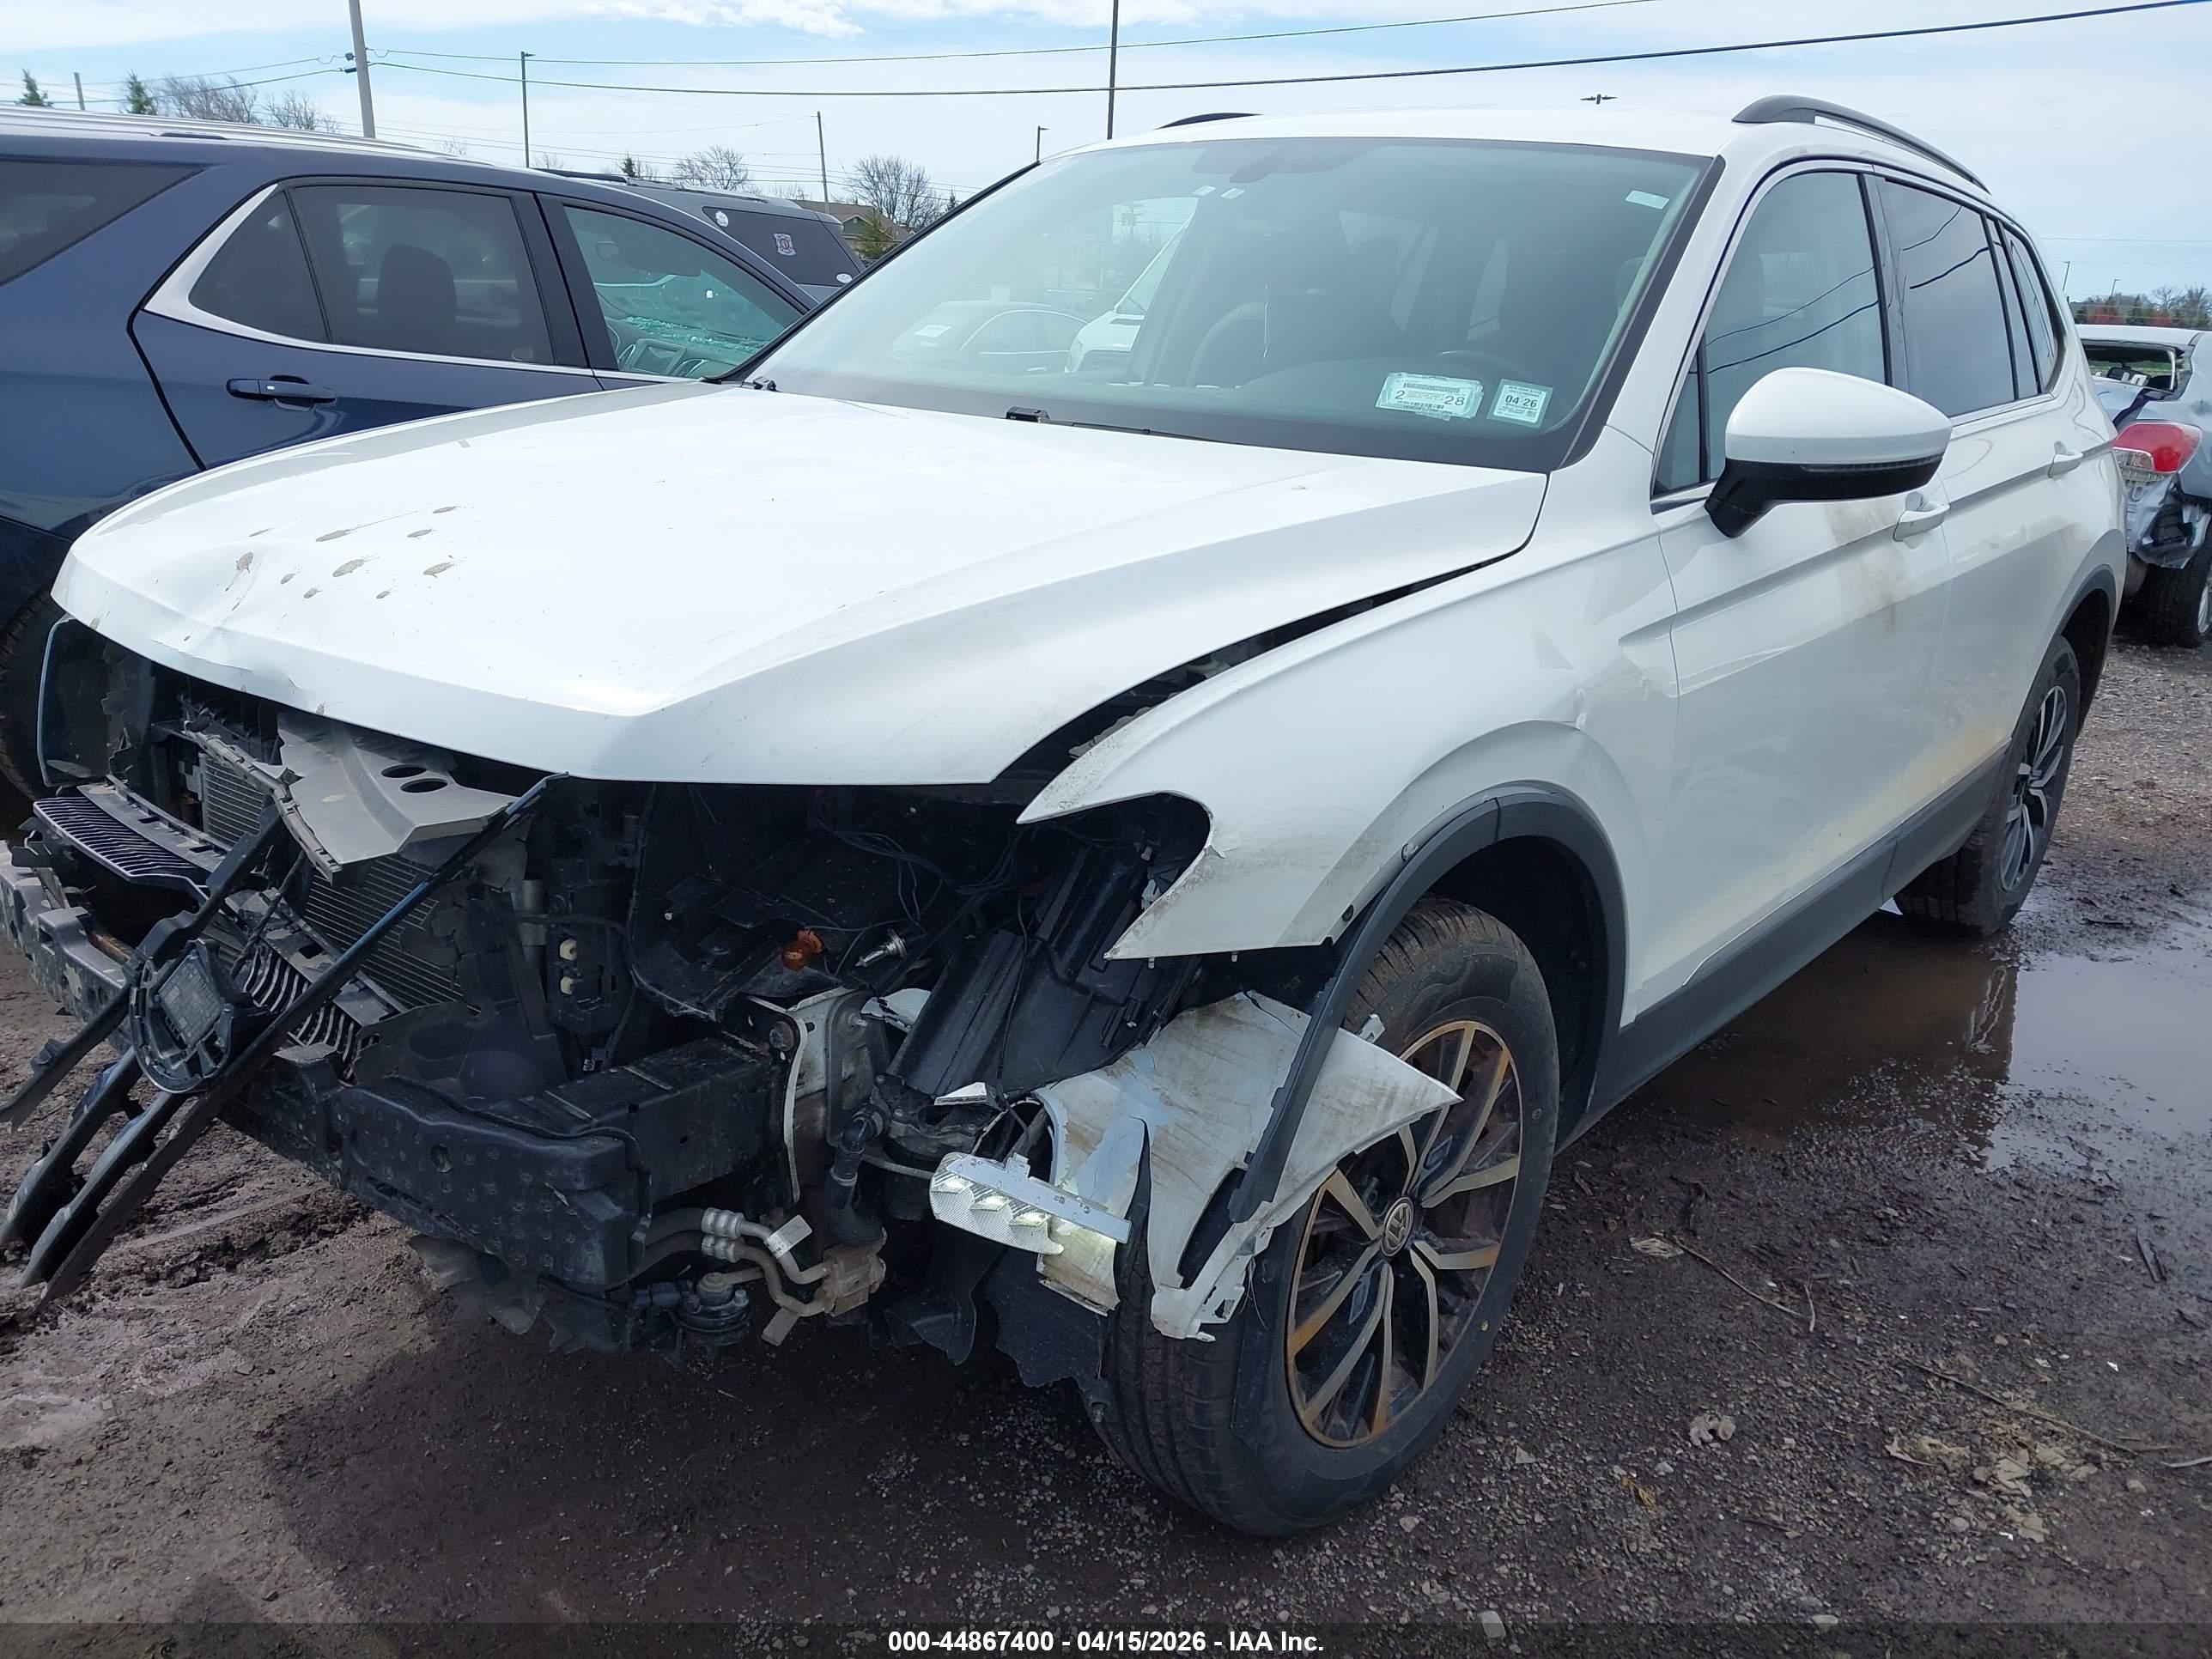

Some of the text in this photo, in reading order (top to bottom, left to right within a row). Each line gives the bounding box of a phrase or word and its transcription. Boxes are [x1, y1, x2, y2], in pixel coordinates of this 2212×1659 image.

[1395, 391, 1406, 400] 2
[1444, 395, 1465, 406] 28
[1505, 395, 1520, 405] 04
[1522, 398, 1538, 408] 26
